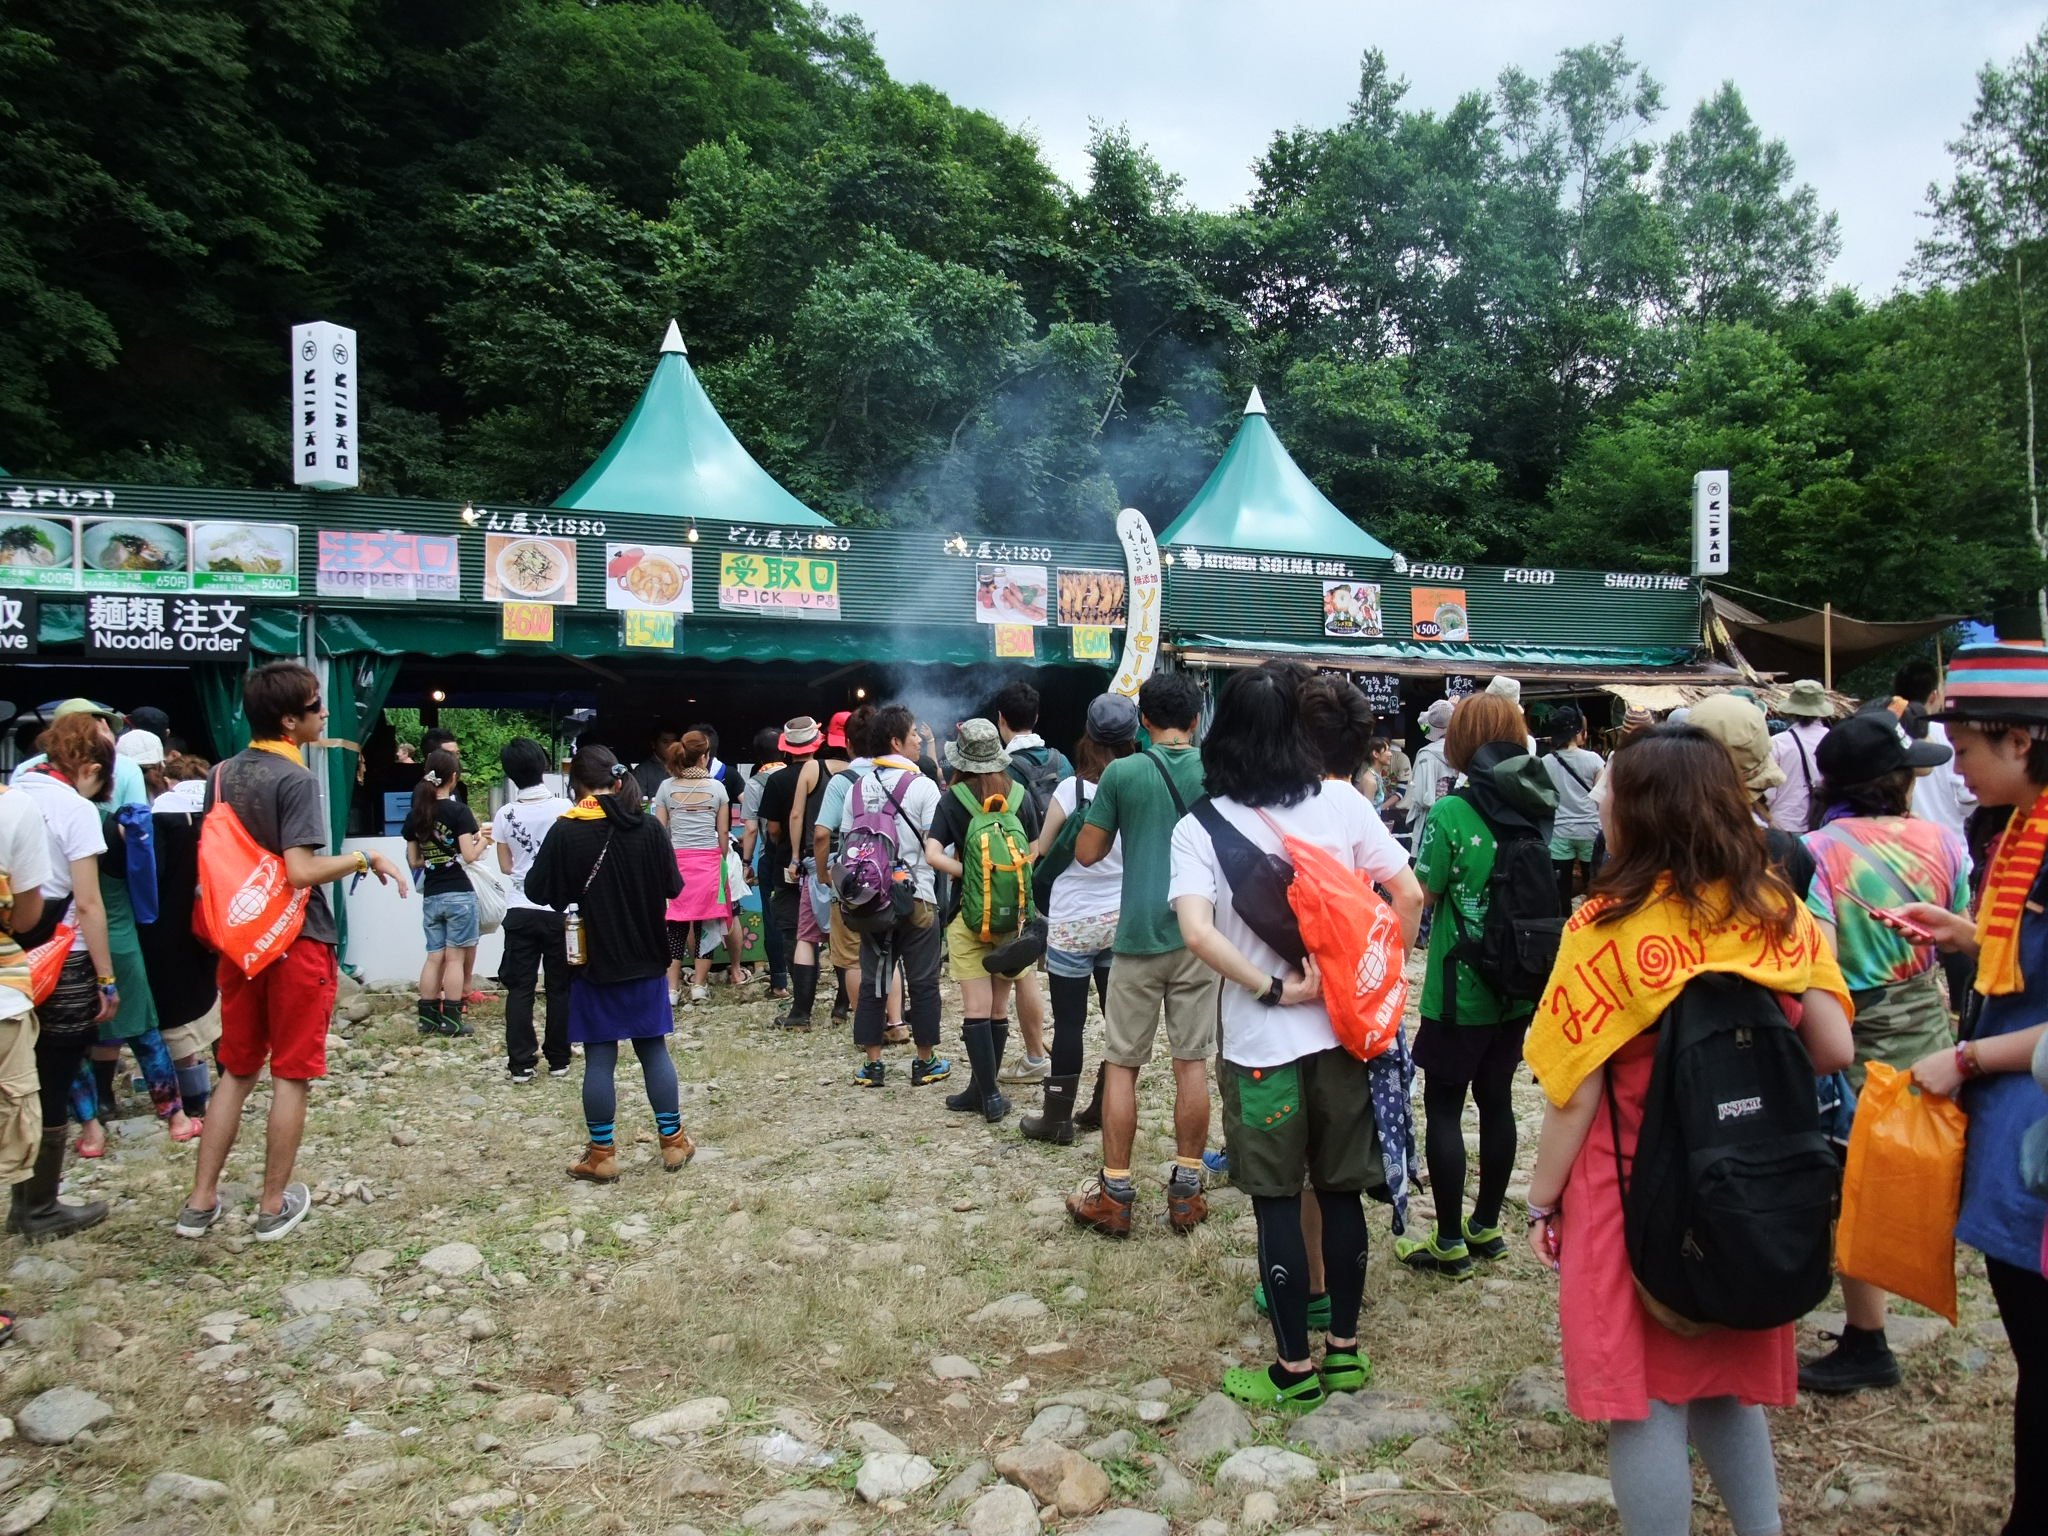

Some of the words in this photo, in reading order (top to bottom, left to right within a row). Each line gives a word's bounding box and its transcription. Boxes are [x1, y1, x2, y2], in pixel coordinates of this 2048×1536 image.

[322, 533, 456, 573] 注文口
[725, 555, 835, 592] 受取口
[1204, 553, 1257, 571] KITCHEN
[1316, 561, 1346, 576] CAFE
[1409, 564, 1464, 581] FOOD
[156, 574, 187, 589] 650円
[261, 577, 291, 591] 500円
[336, 570, 405, 587] ORDER
[1504, 568, 1555, 584] FOOD
[1604, 573, 1690, 591] SMOOTHIE
[737, 590, 782, 604] PICK
[801, 594, 825, 605] UP
[89, 595, 164, 633] 麺類
[173, 599, 246, 634] 注文
[505, 605, 552, 638] ¥600
[94, 631, 173, 650] Noodle
[179, 632, 242, 652] Order
